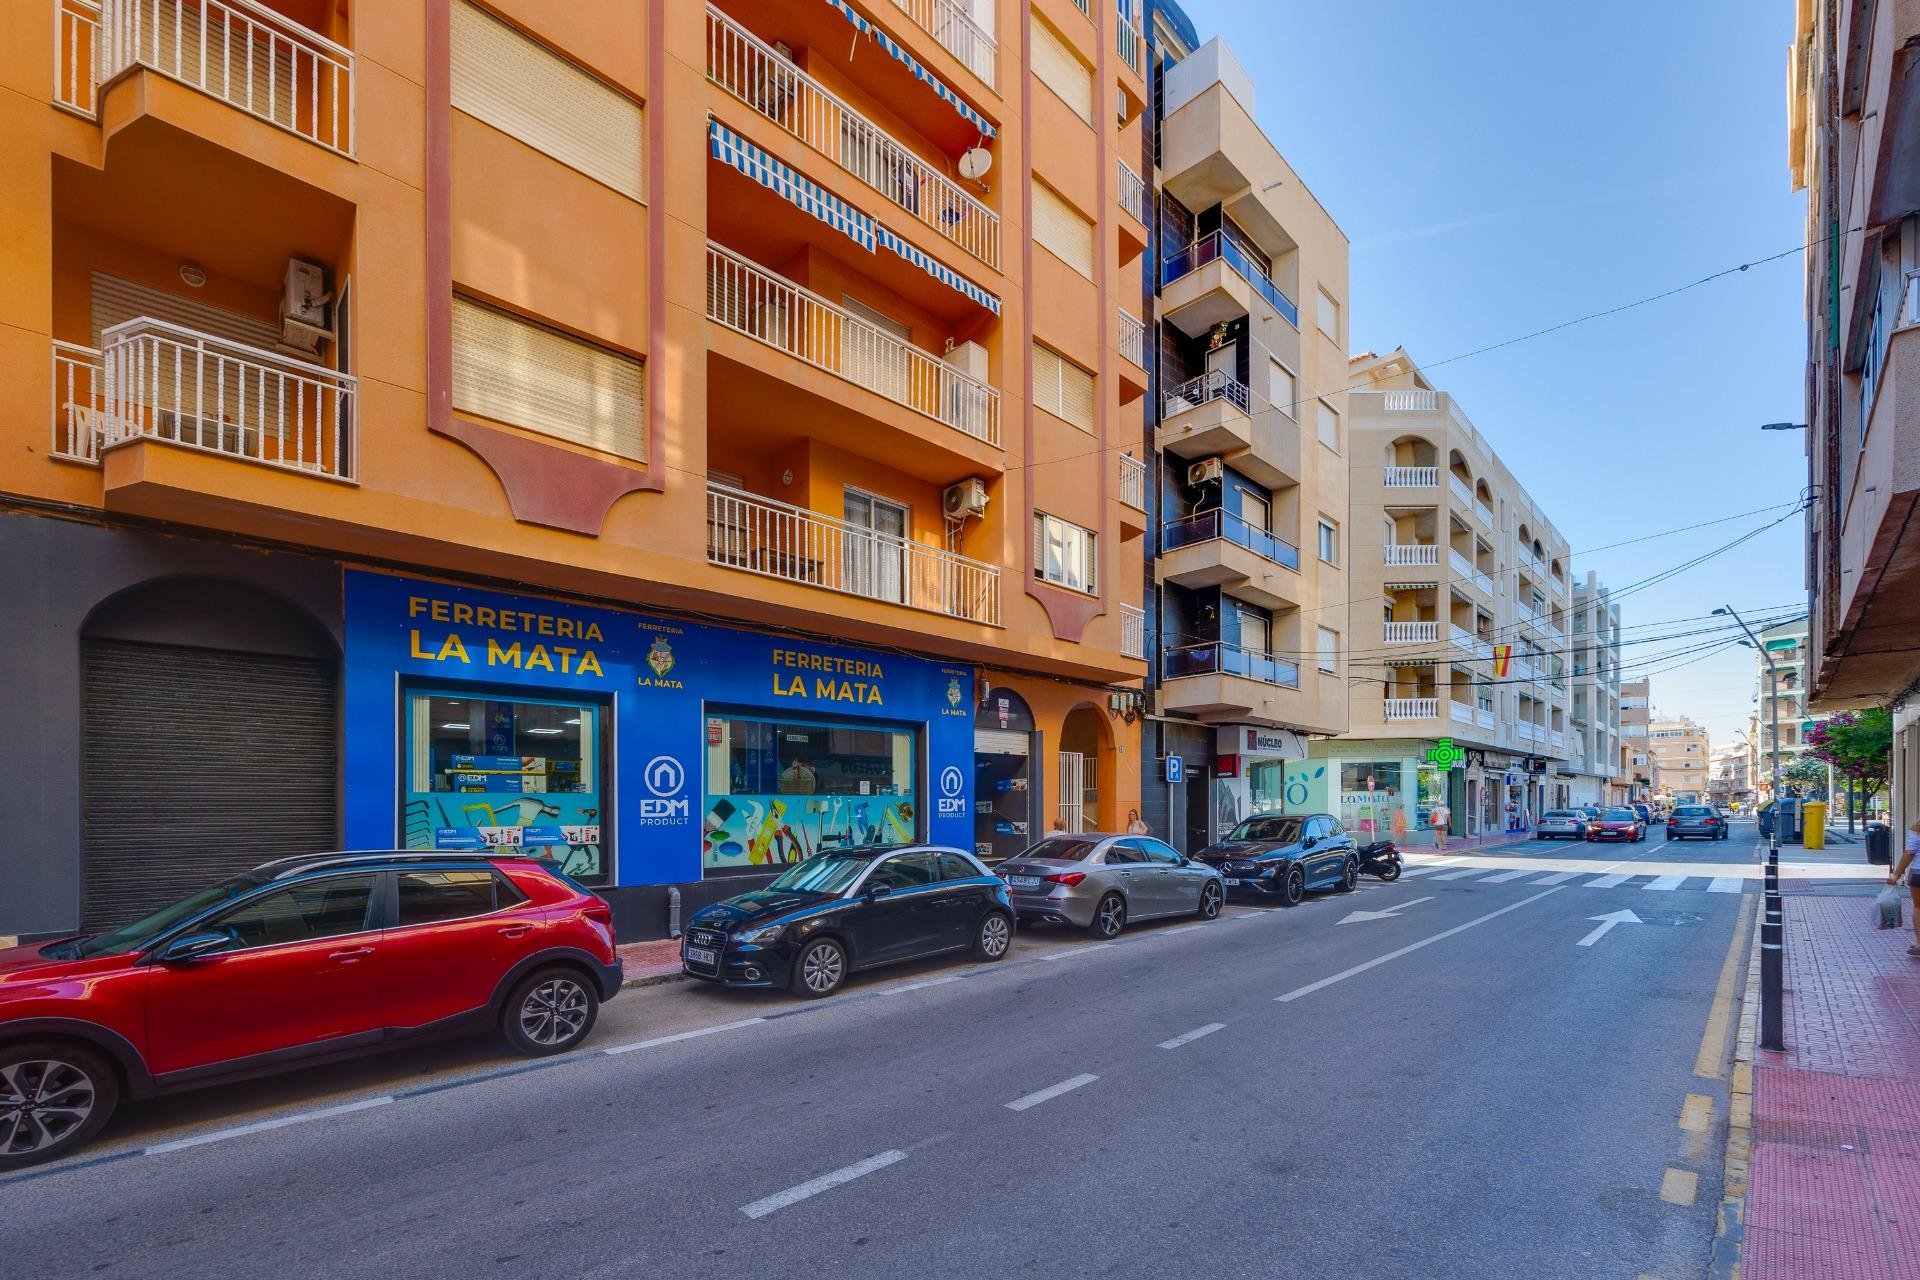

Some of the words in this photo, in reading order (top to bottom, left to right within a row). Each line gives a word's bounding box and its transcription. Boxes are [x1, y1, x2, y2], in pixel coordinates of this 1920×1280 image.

[409, 596, 604, 642] FERRETERIA
[638, 622, 684, 635] FERRETERIA
[410, 629, 471, 664] LA
[487, 638, 604, 677] MATA
[773, 648, 884, 679] FERRETERIA
[638, 677, 652, 686] LA
[654, 679, 683, 689] MATA
[773, 673, 808, 697] LA
[816, 678, 883, 705] MATA
[950, 709, 967, 717] MATA
[1257, 734, 1283, 749] NÚCLEO
[1170, 759, 1179, 779] P
[466, 774, 487, 782] EDM
[640, 799, 689, 817] EDM
[938, 798, 966, 812] EDM
[640, 817, 689, 826] PRODUCT
